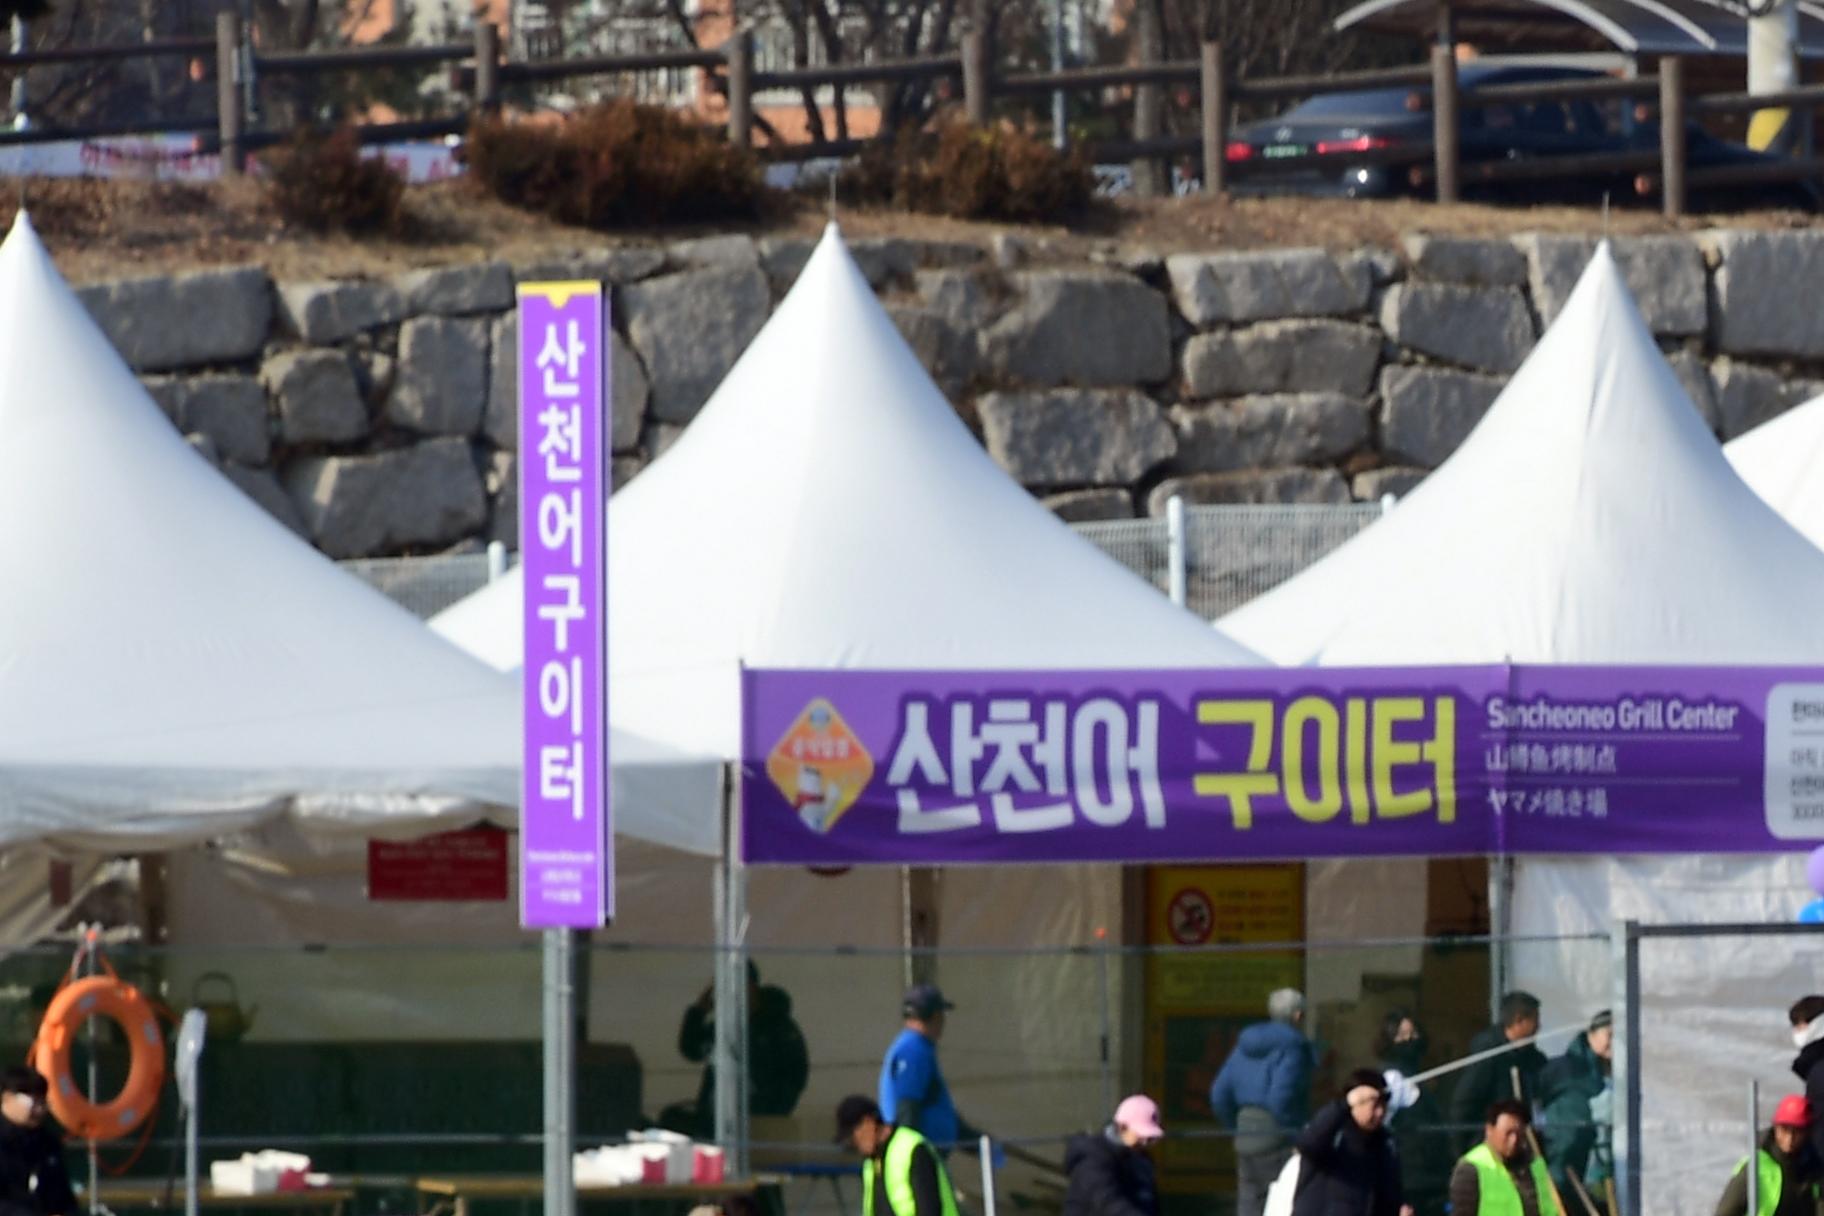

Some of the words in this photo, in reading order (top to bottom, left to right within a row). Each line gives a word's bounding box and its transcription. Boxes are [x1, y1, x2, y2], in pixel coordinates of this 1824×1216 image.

[537, 319, 585, 820] 산천어구이터
[886, 697, 1167, 834] 산천어
[1193, 696, 1457, 829] 구이터
[1487, 698, 1616, 730] Sancheoneo
[1618, 700, 1663, 730] Grill
[1667, 701, 1738, 730] Center
